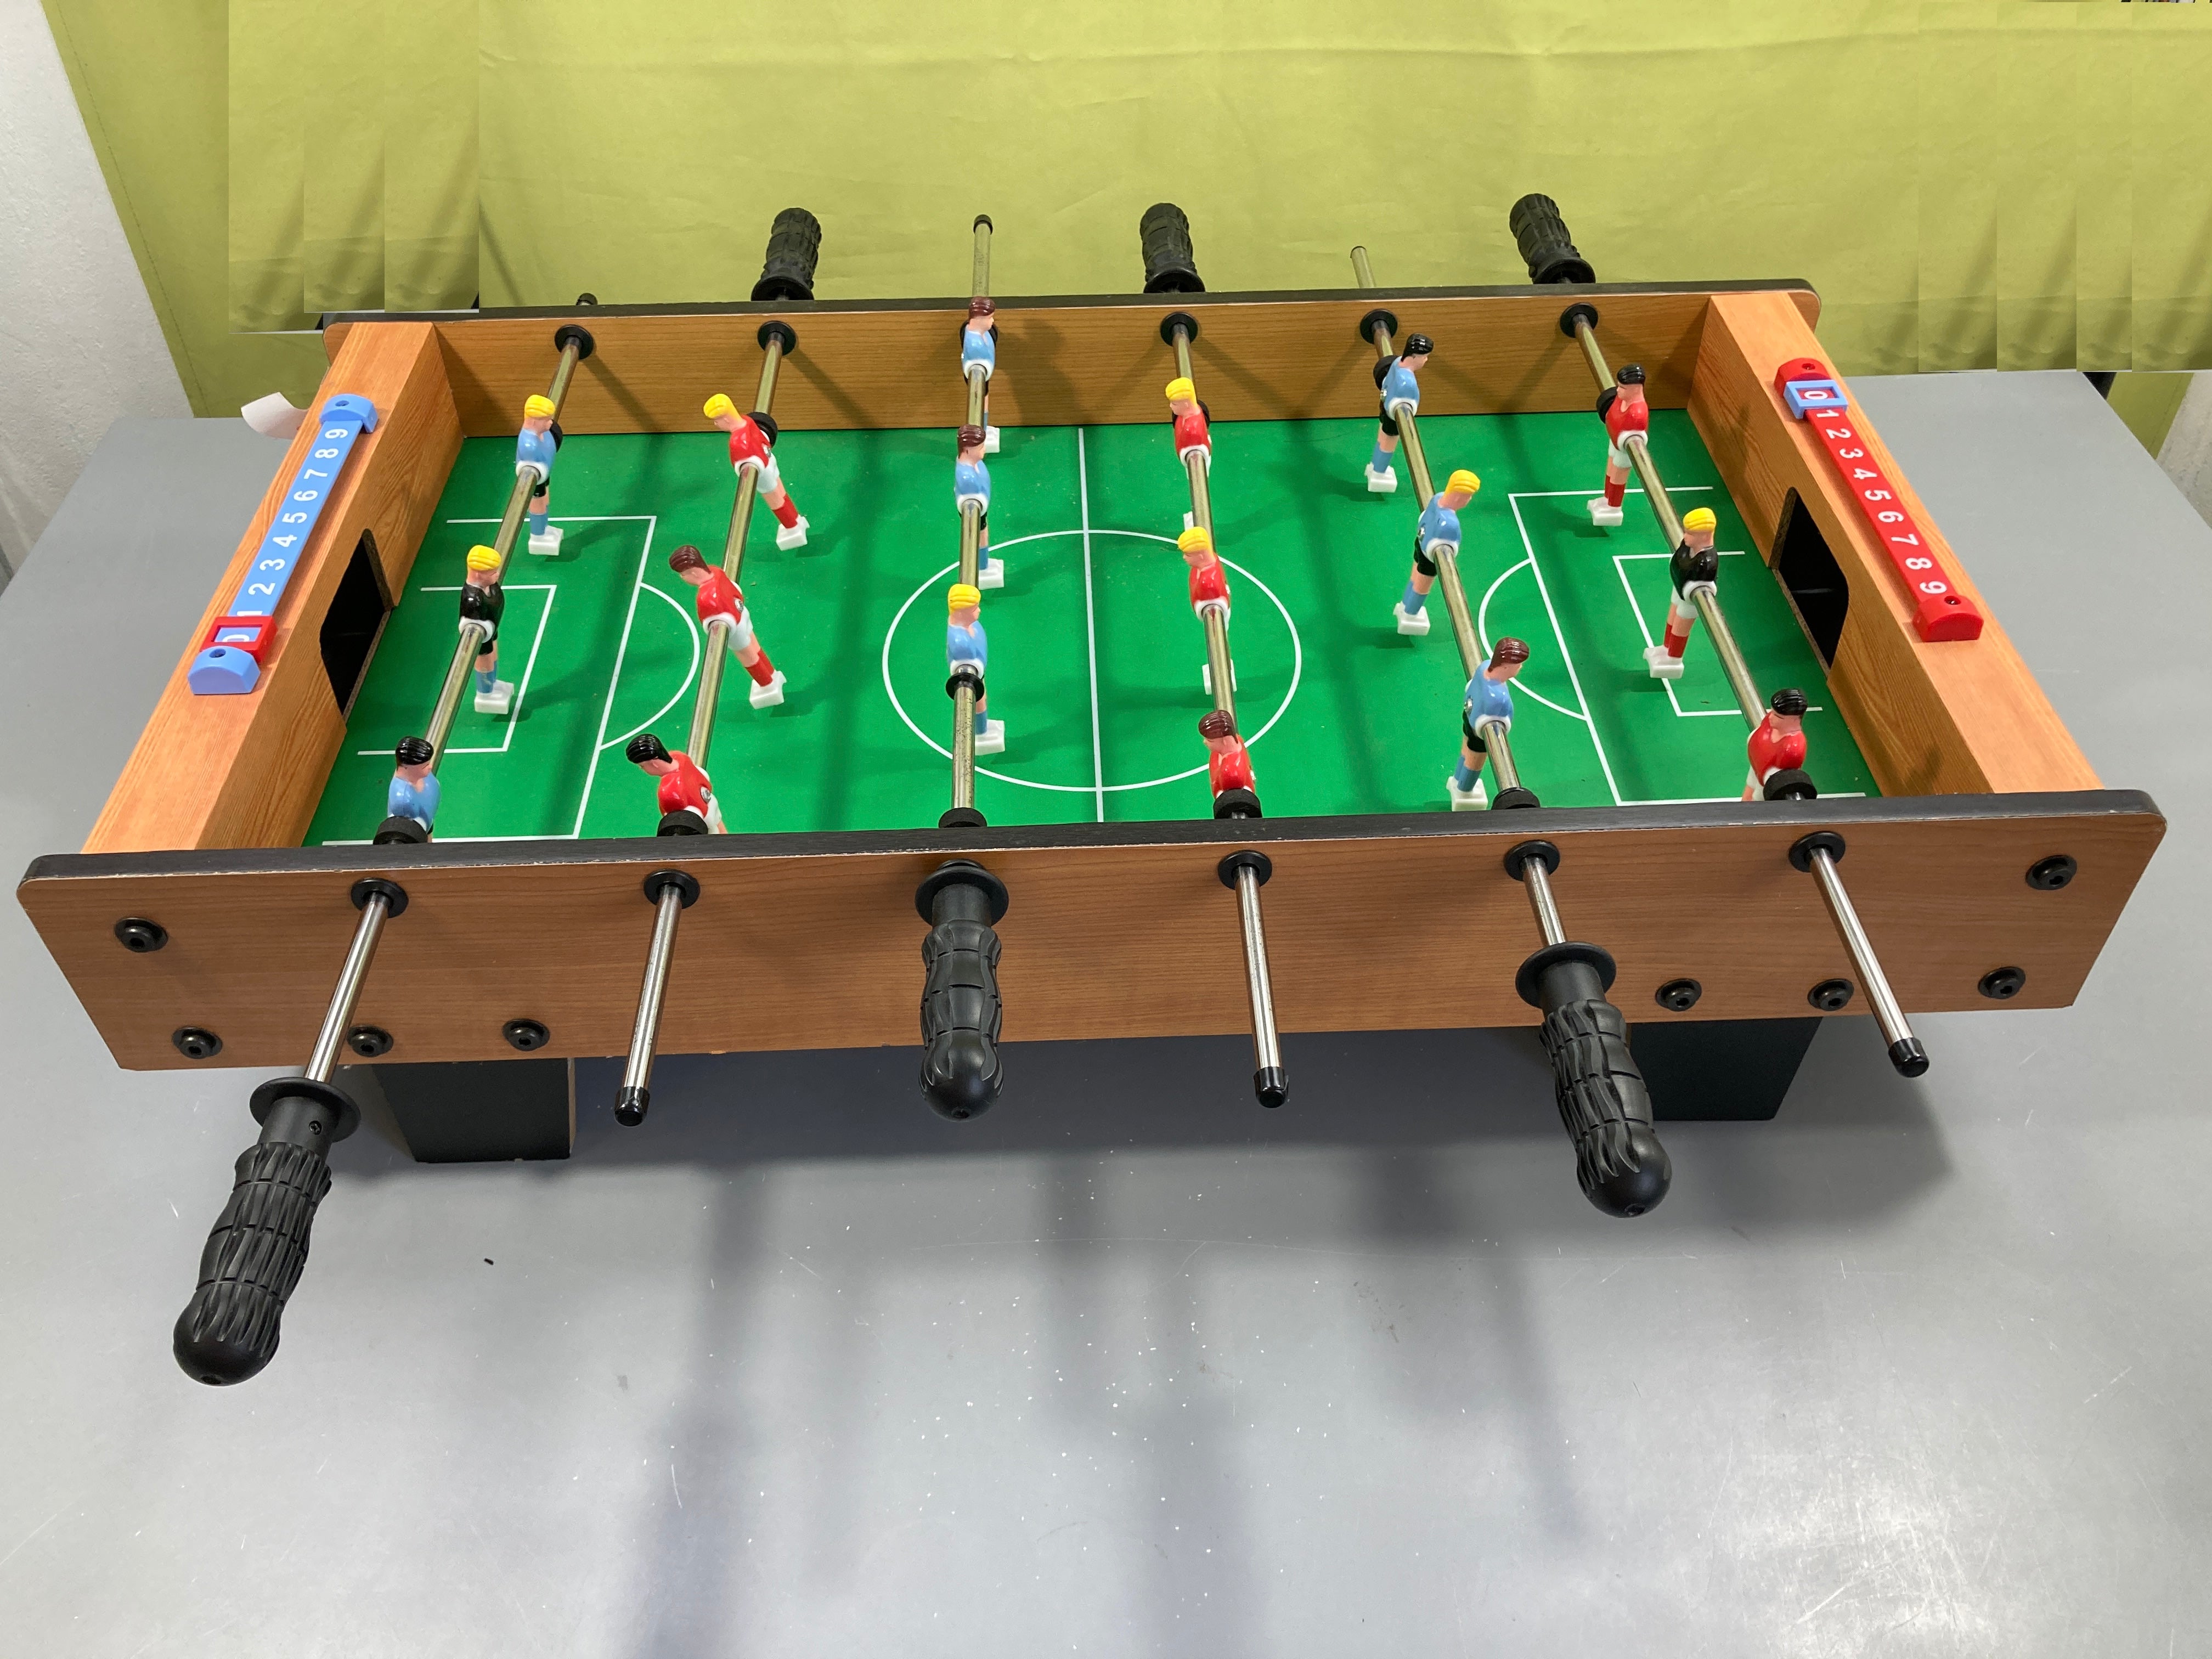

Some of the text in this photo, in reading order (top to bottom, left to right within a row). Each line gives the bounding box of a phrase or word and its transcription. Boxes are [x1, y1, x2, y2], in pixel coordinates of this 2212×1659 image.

[324, 428, 348, 439] 9
[314, 448, 339, 459] 8
[303, 469, 328, 479] 7
[293, 490, 318, 501] 6
[1804, 391, 1947, 594] 0 1 2 3 4 5 6 7 8 9
[281, 512, 307, 523] 5
[272, 534, 297, 548] 4
[259, 558, 286, 571] 3
[248, 583, 276, 595] 2
